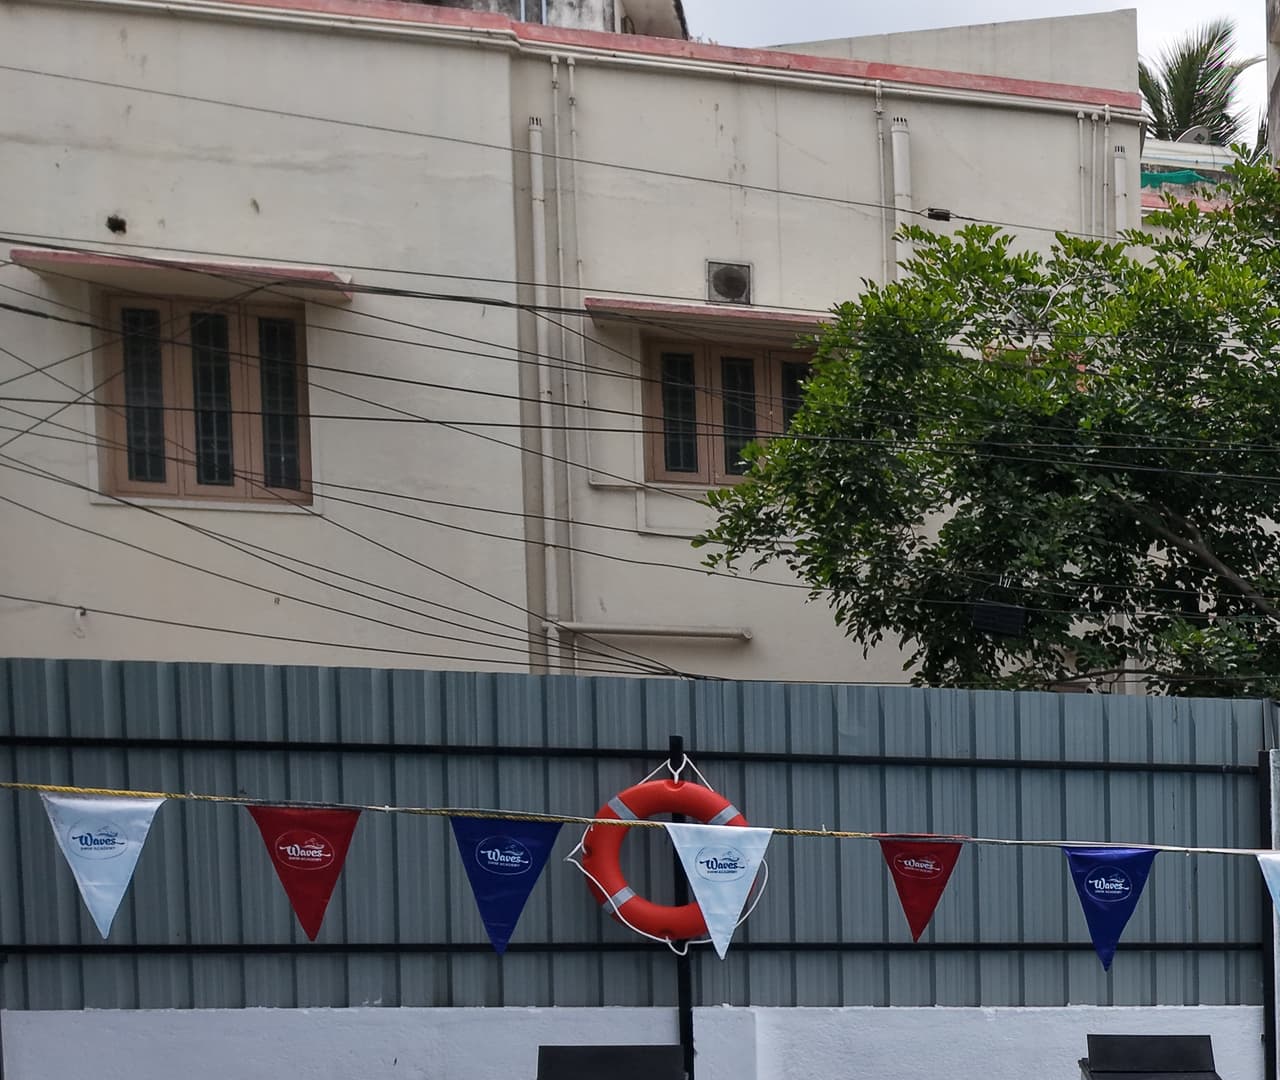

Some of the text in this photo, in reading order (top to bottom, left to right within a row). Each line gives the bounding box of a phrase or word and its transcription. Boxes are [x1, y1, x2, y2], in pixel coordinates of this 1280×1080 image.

[72, 832, 125, 847] Waves
[279, 844, 331, 858] Waves
[480, 848, 529, 864] Waves
[699, 857, 745, 870] Waves
[897, 859, 941, 871] Waves
[1088, 877, 1130, 890] Waves
